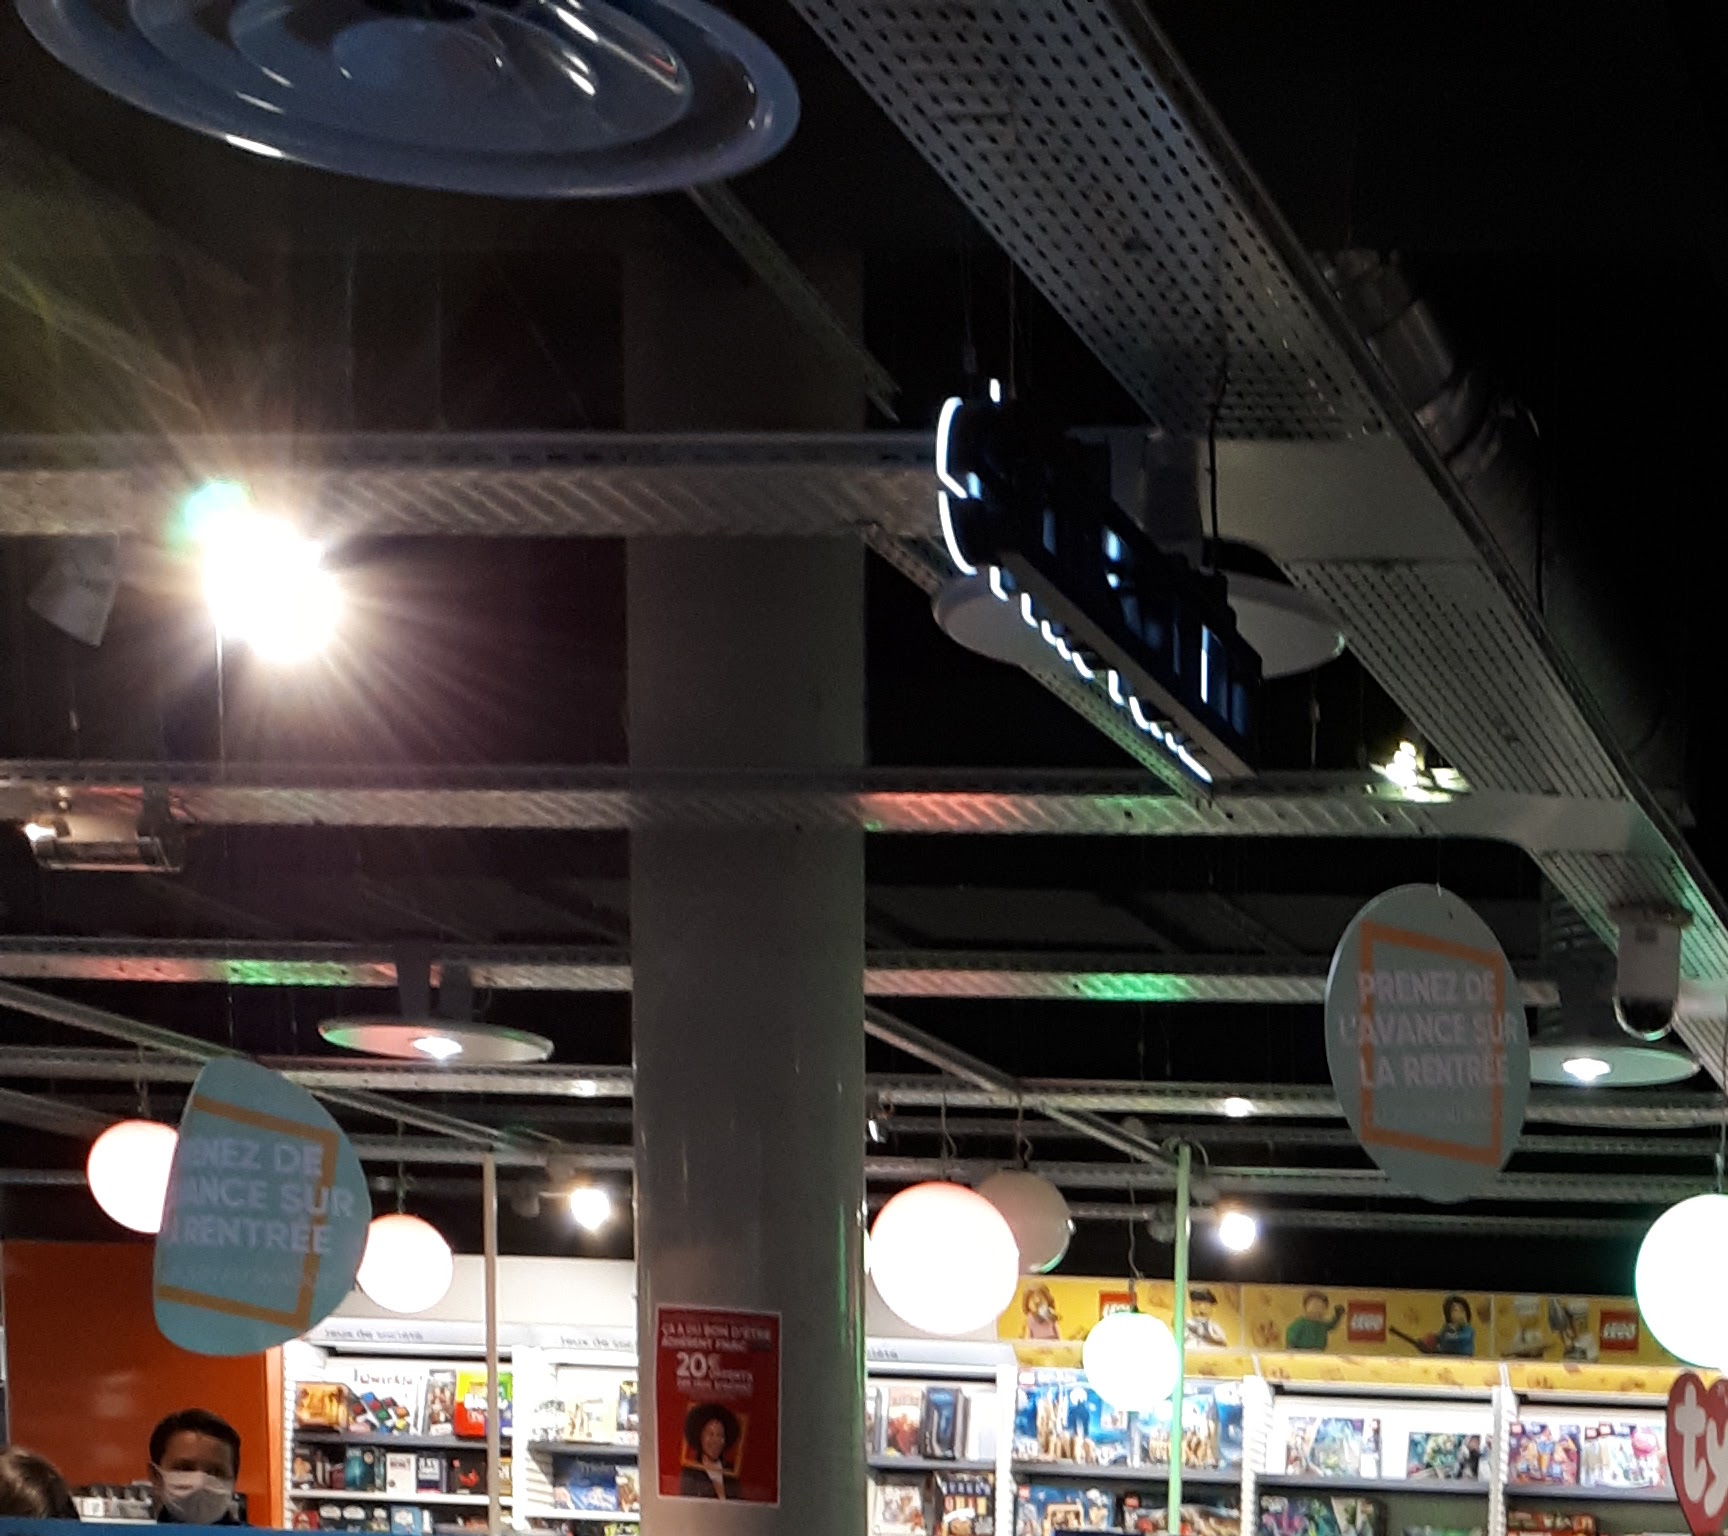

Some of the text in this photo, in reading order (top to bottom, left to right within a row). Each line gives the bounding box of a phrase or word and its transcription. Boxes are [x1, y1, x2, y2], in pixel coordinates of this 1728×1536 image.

[1359, 971, 1496, 1003] PRENEZ DE
[1472, 1013, 1519, 1044] SUR
[1360, 1054, 1394, 1087] LA
[274, 1142, 323, 1176] DE
[280, 1183, 355, 1217] SUR
[1350, 1312, 1384, 1330] LEGO
